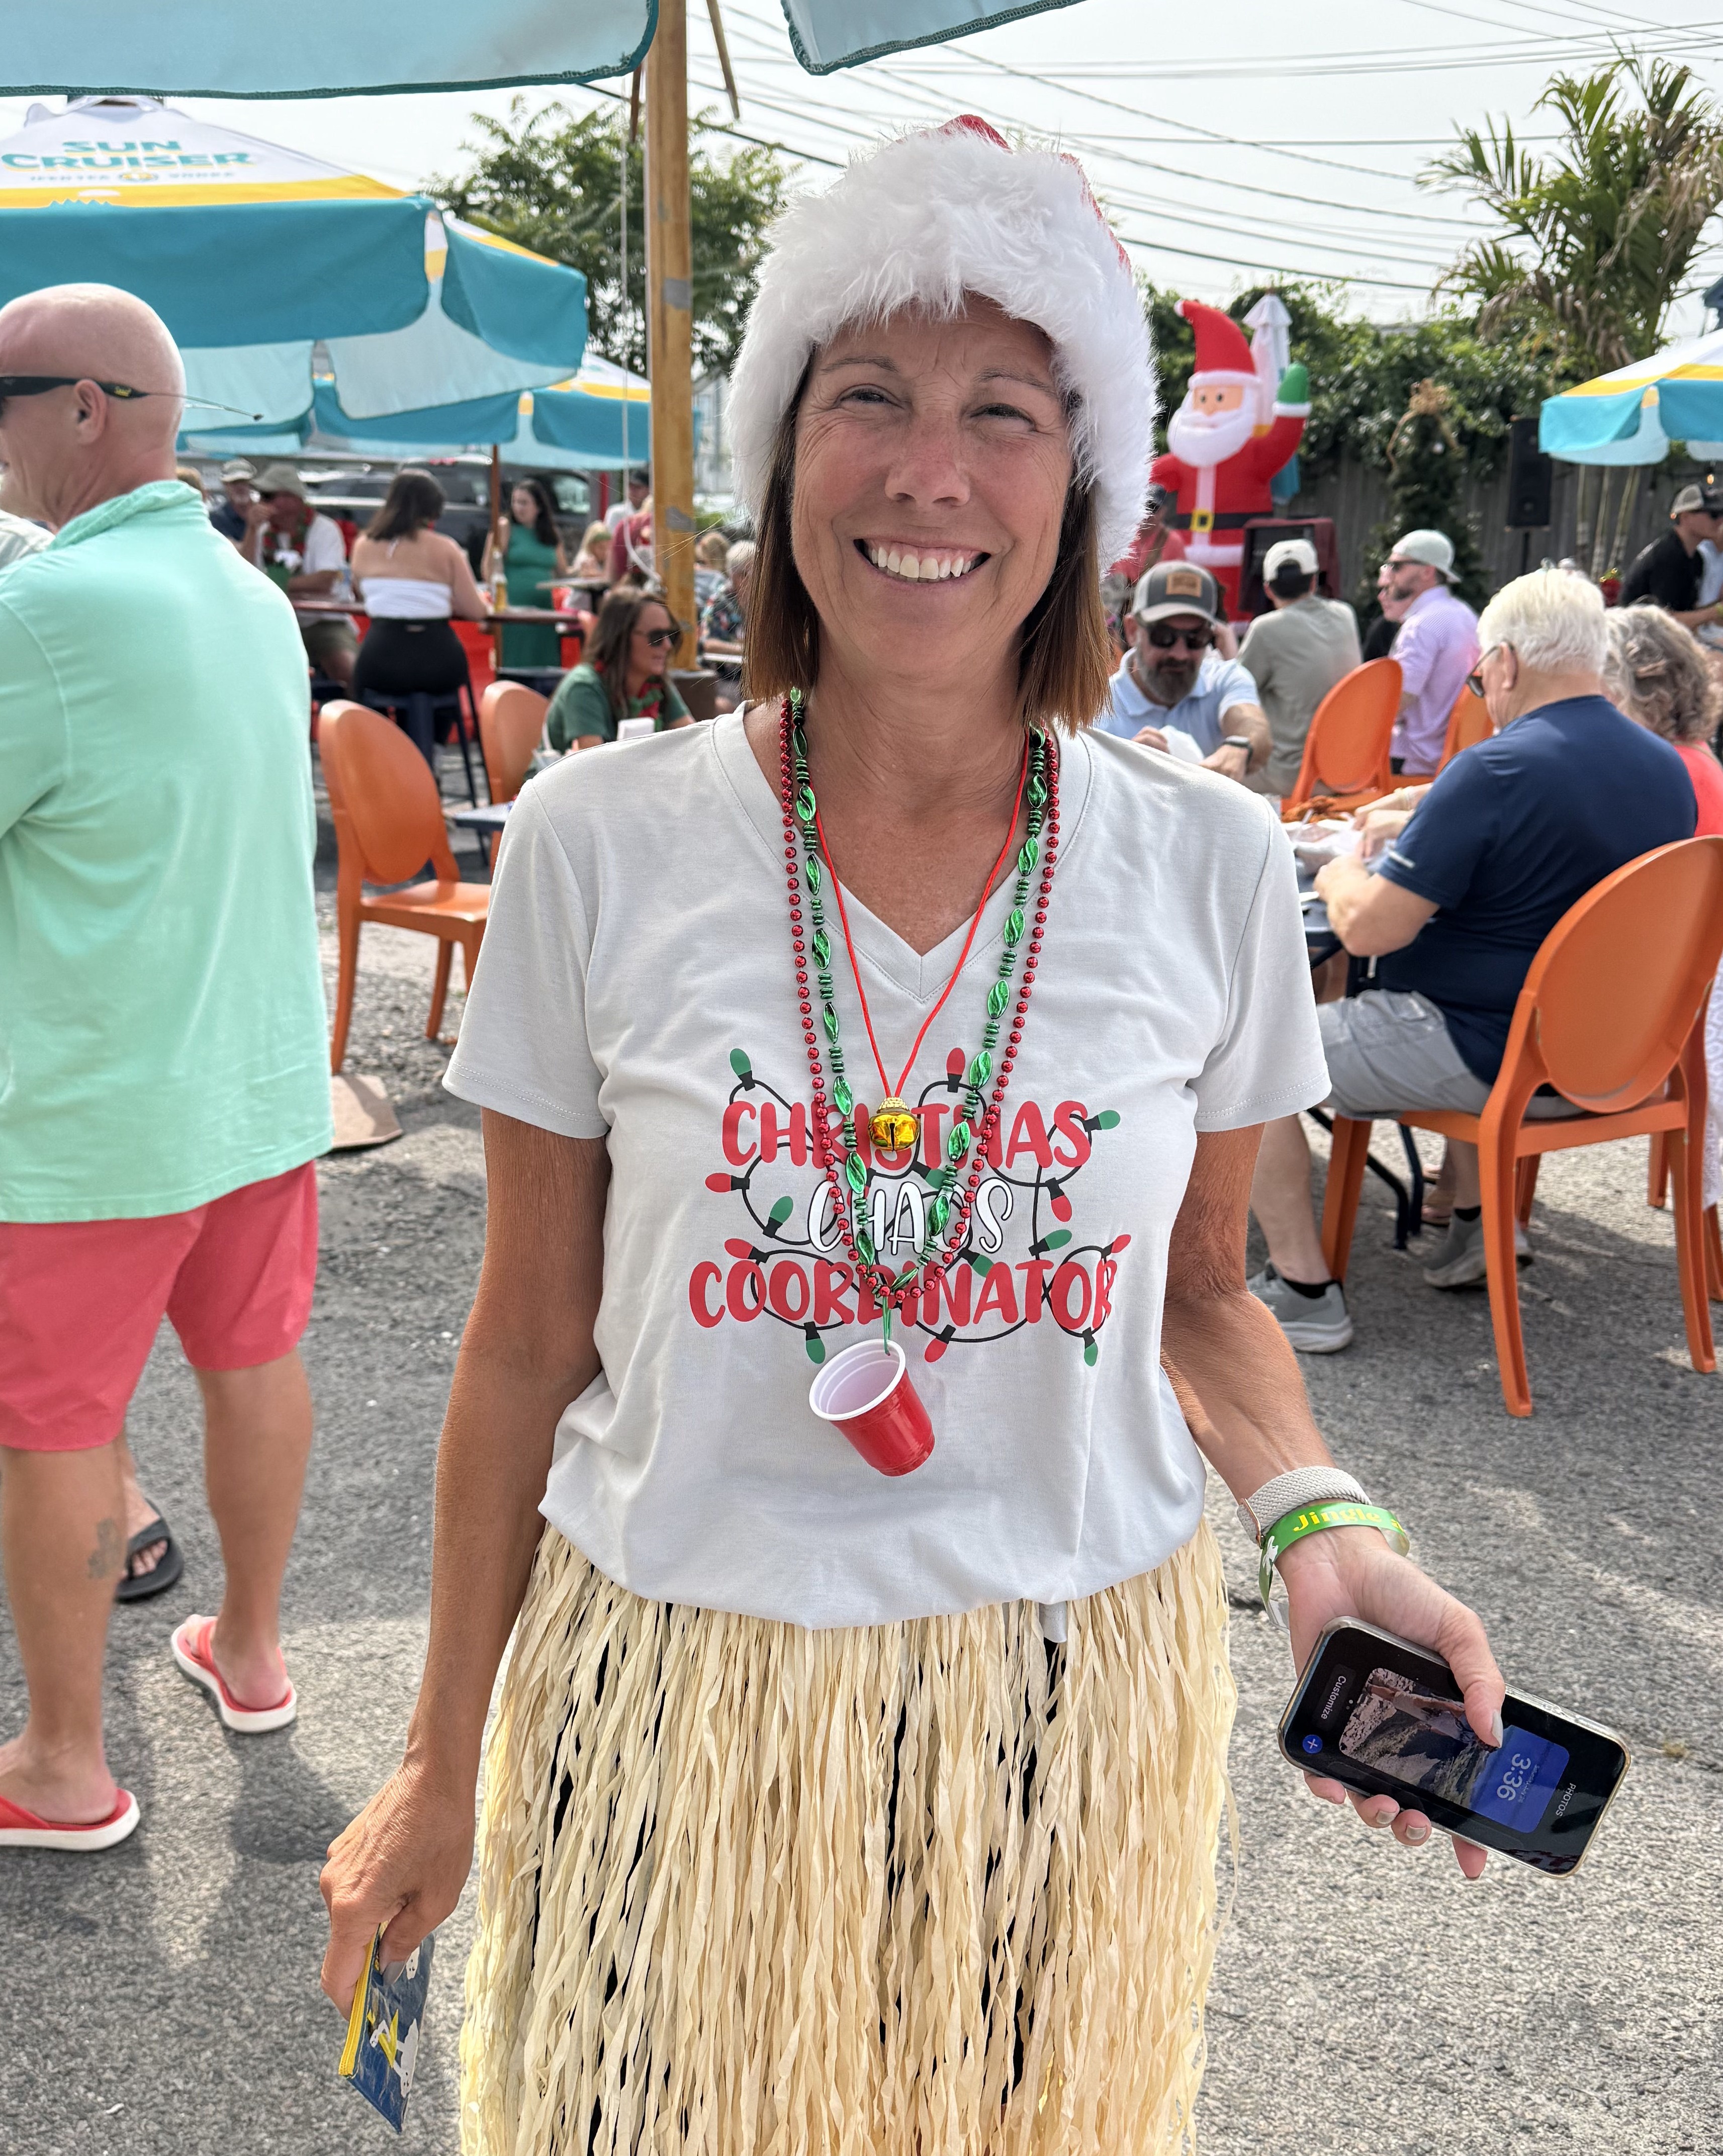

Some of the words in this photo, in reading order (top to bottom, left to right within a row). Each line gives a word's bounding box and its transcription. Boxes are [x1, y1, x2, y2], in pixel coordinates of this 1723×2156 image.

[1, 152, 255, 171] CRUISER
[62, 141, 183, 155] SUN
[807, 1177, 1013, 1255] CHAOS
[689, 1260, 1117, 1329] COORDINATOR
[1293, 1508, 1382, 1532] Jingle
[1321, 1675, 1346, 1720] Customize
[1497, 1753, 1531, 1801] 3:36
[1556, 1783, 1576, 1817] PHOTOS
